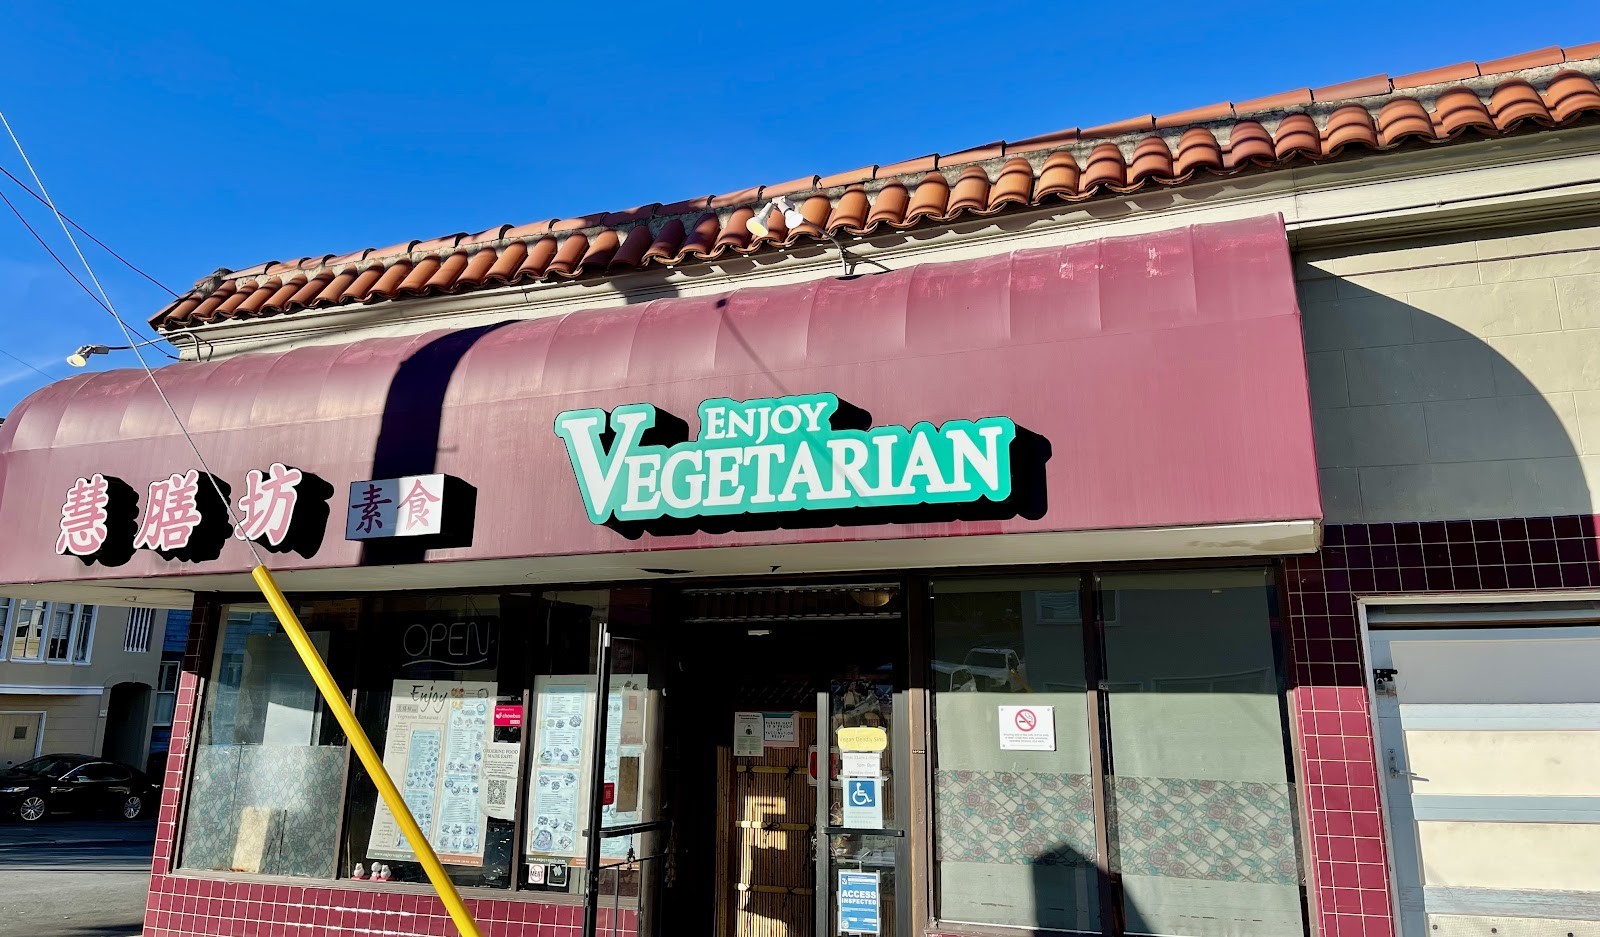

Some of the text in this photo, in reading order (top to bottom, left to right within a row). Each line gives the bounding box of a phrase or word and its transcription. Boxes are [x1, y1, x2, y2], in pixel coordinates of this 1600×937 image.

[704, 400, 828, 445] ENJOY
[561, 412, 1003, 516] VEGETARIAN
[56, 463, 302, 556] 慧膳坊
[351, 479, 441, 534] 素食
[403, 621, 490, 657] OPEN
[410, 685, 448, 714] Enjoy
[842, 889, 877, 899] ACCESS
